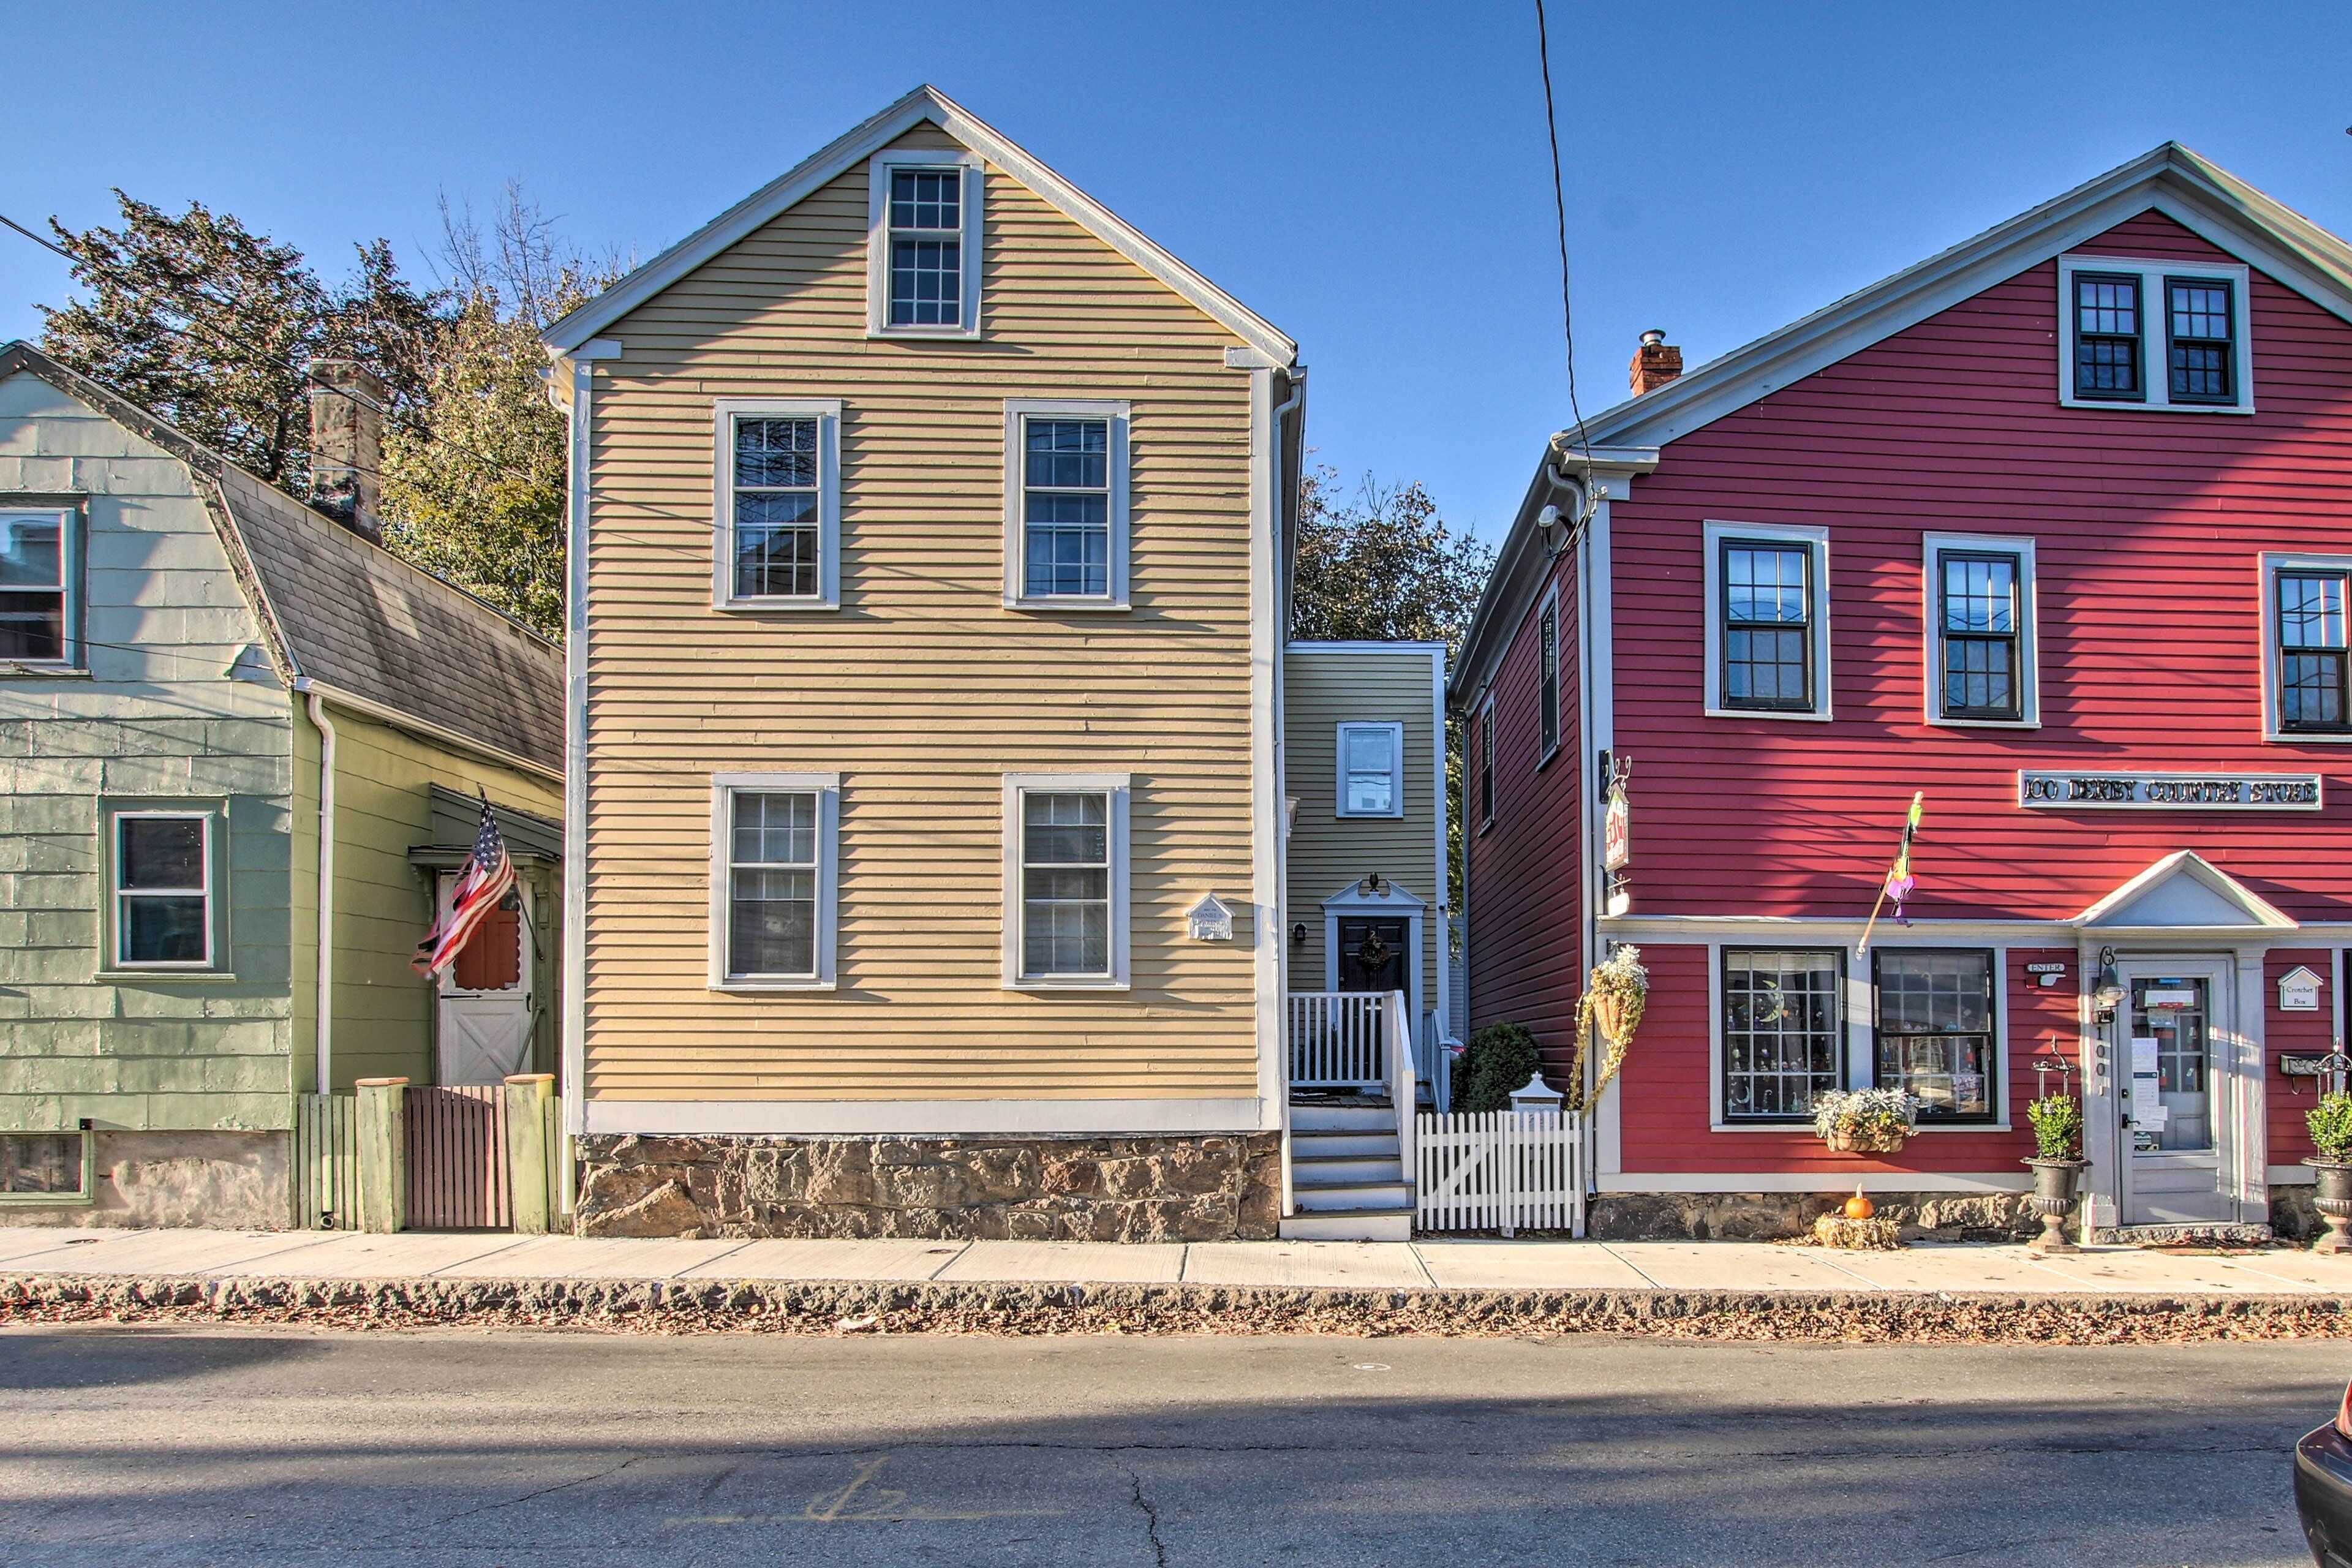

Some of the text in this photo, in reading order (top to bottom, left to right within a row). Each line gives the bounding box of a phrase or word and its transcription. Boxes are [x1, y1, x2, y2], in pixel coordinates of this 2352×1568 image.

[2024, 778, 2317, 802] 100 DERBY COUNTRY STORE
[2096, 1026, 2105, 1077] 100
